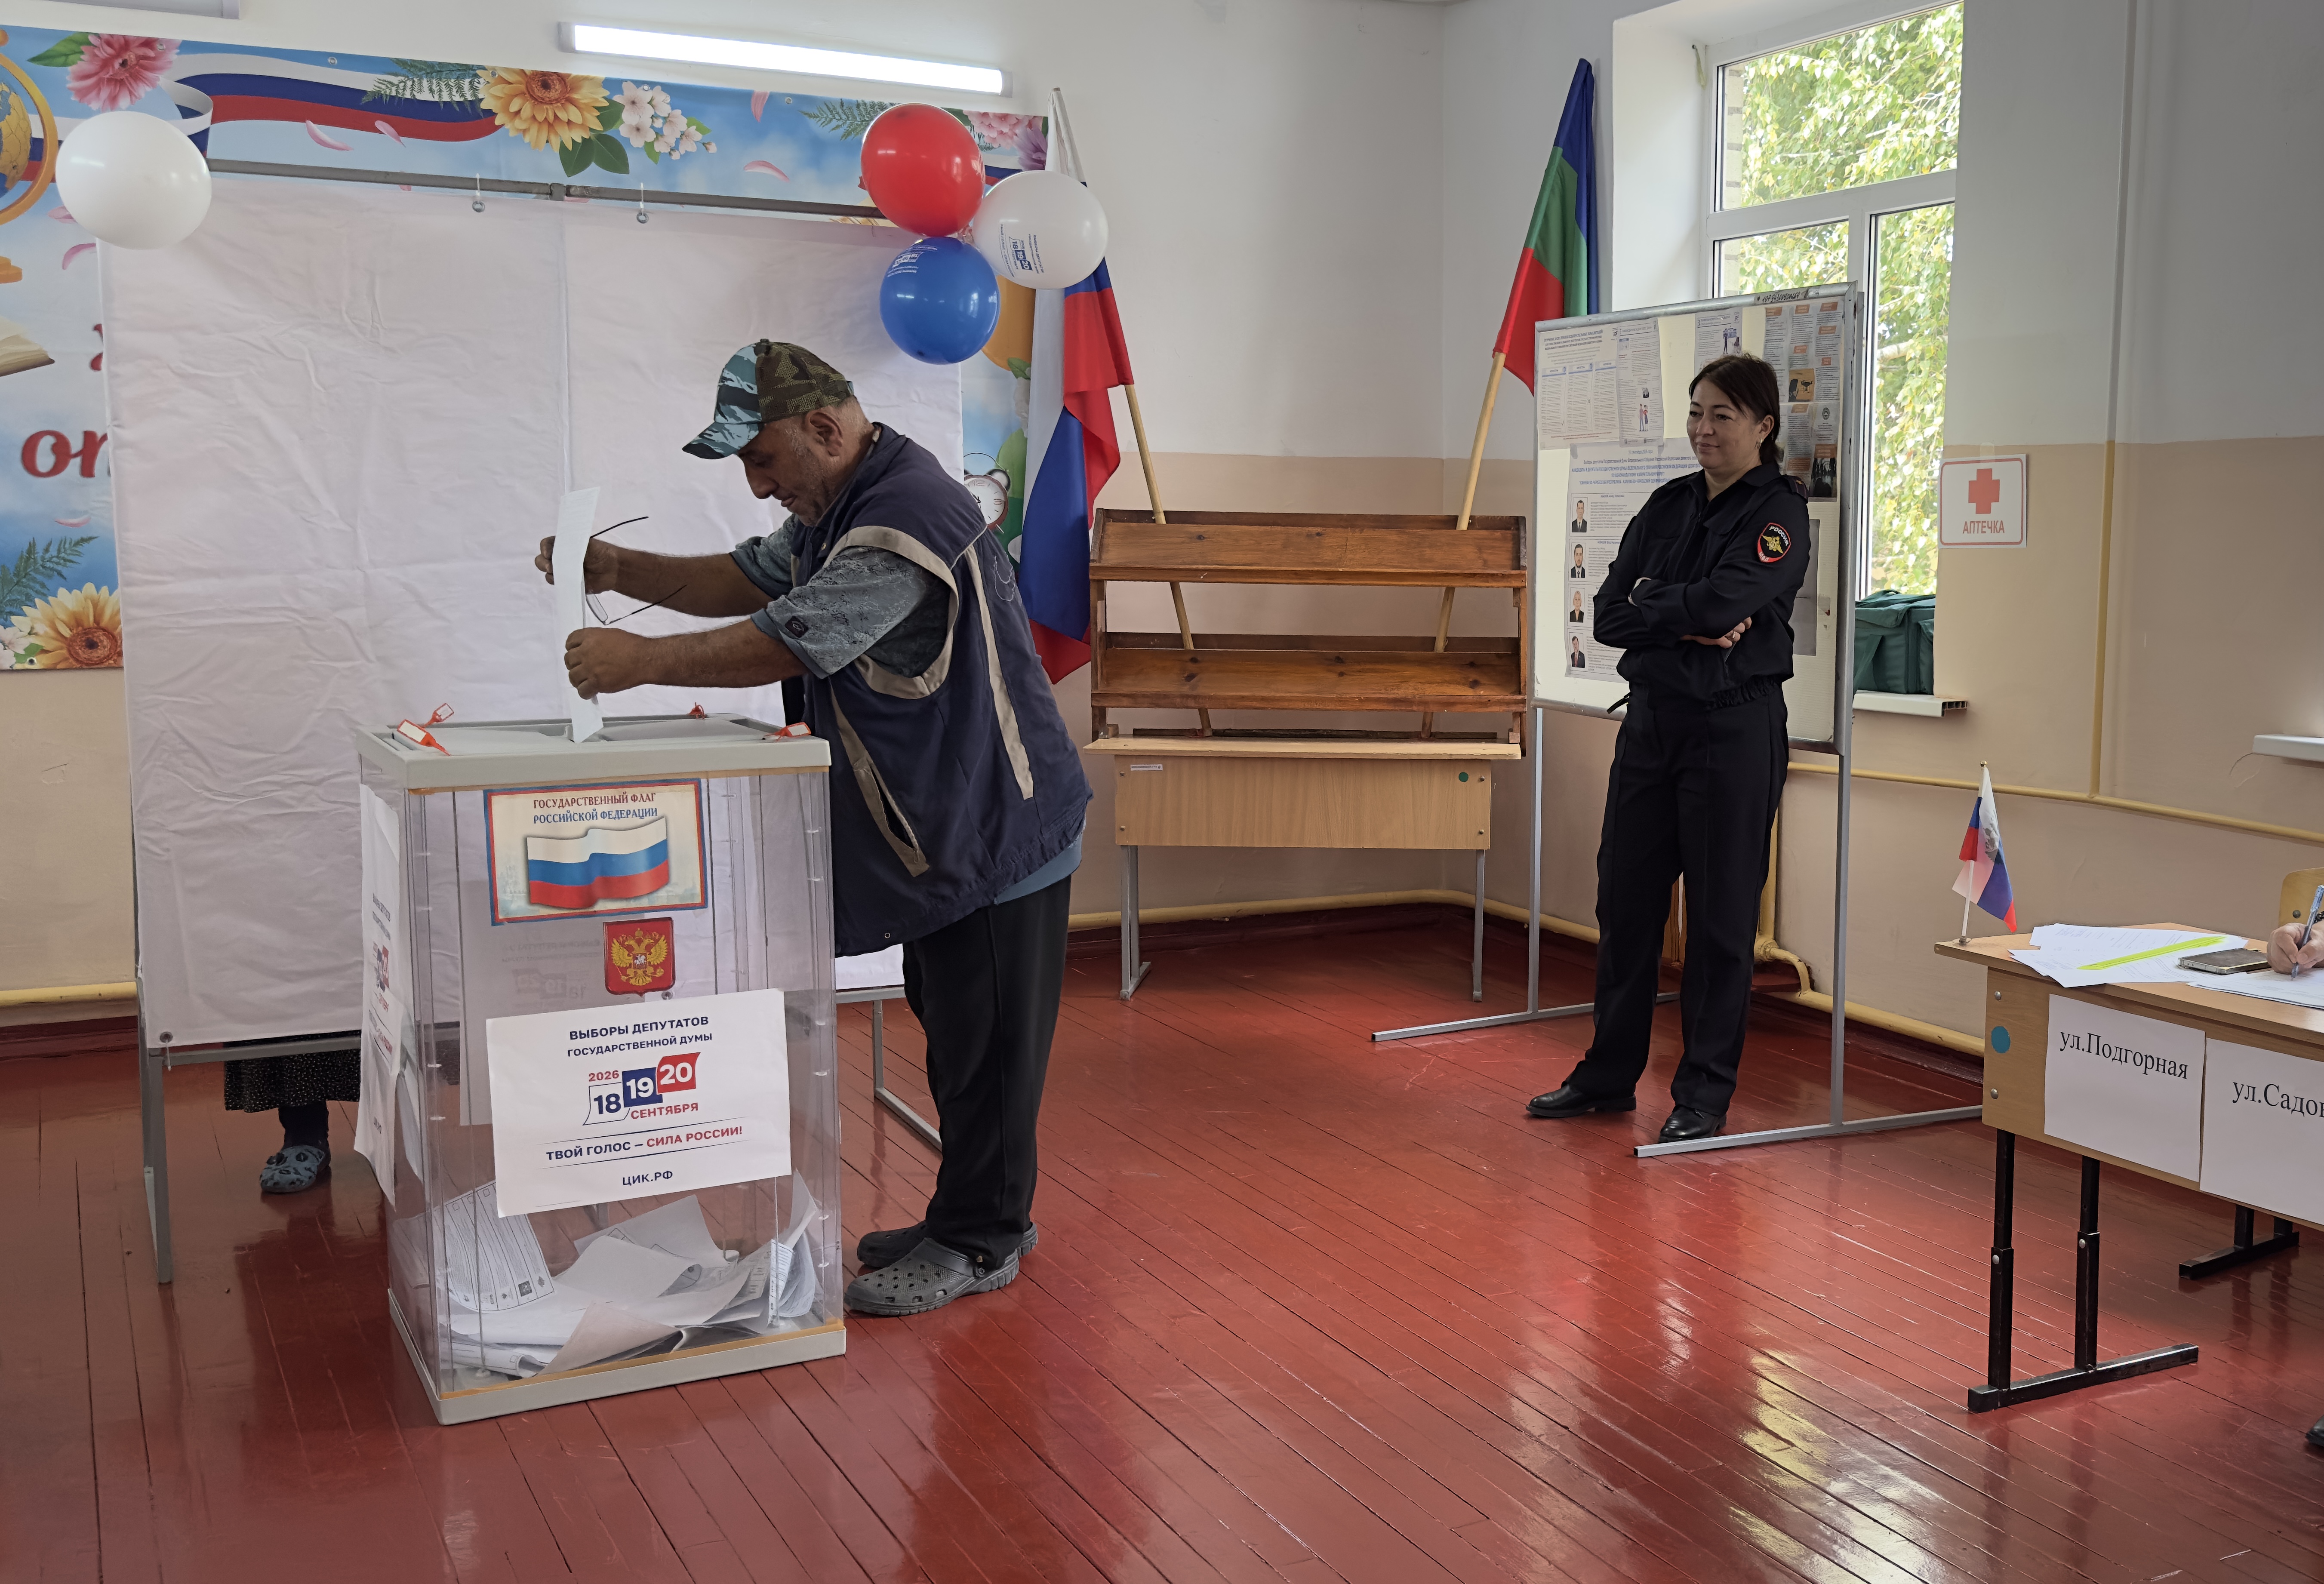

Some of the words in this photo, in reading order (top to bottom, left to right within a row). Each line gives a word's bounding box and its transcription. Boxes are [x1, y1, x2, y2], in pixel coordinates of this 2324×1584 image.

[1012, 241, 1019, 249] 18
[1016, 251, 1024, 259] 19
[1022, 260, 1030, 269] 20
[1769, 526, 1789, 547] РОССИЯ
[1963, 520, 2005, 534] АПТЕЧКА
[533, 791, 628, 809] ГОСУДАРСТВЕННЫЙ
[631, 793, 656, 803] ФЛАГ
[533, 809, 598, 824] РОССИЙСКОЙ
[600, 808, 658, 820] ФЕДЕРАЦИИ
[569, 1025, 628, 1040] ВЫБОРЫ
[632, 1016, 709, 1034] ДЕПУТАТОВ
[568, 1035, 677, 1057] ГОСУДАРСТВЕННОЙ
[680, 1033, 712, 1045] ДУМЫ
[2059, 1031, 2189, 1080] ул.Подгорная
[588, 1070, 619, 1082] 2026
[594, 1093, 622, 1114] 18
[626, 1077, 654, 1099] 19
[659, 1062, 693, 1085] 20
[631, 1102, 699, 1119] СЕНТЯБРЯ
[546, 1146, 583, 1160] ТВОЙ
[587, 1141, 631, 1155] ГОЛОС
[646, 1135, 682, 1147] СИЛА
[686, 1126, 742, 1142] РОССИИ!
[622, 1170, 673, 1186] ЦИК.РФ
